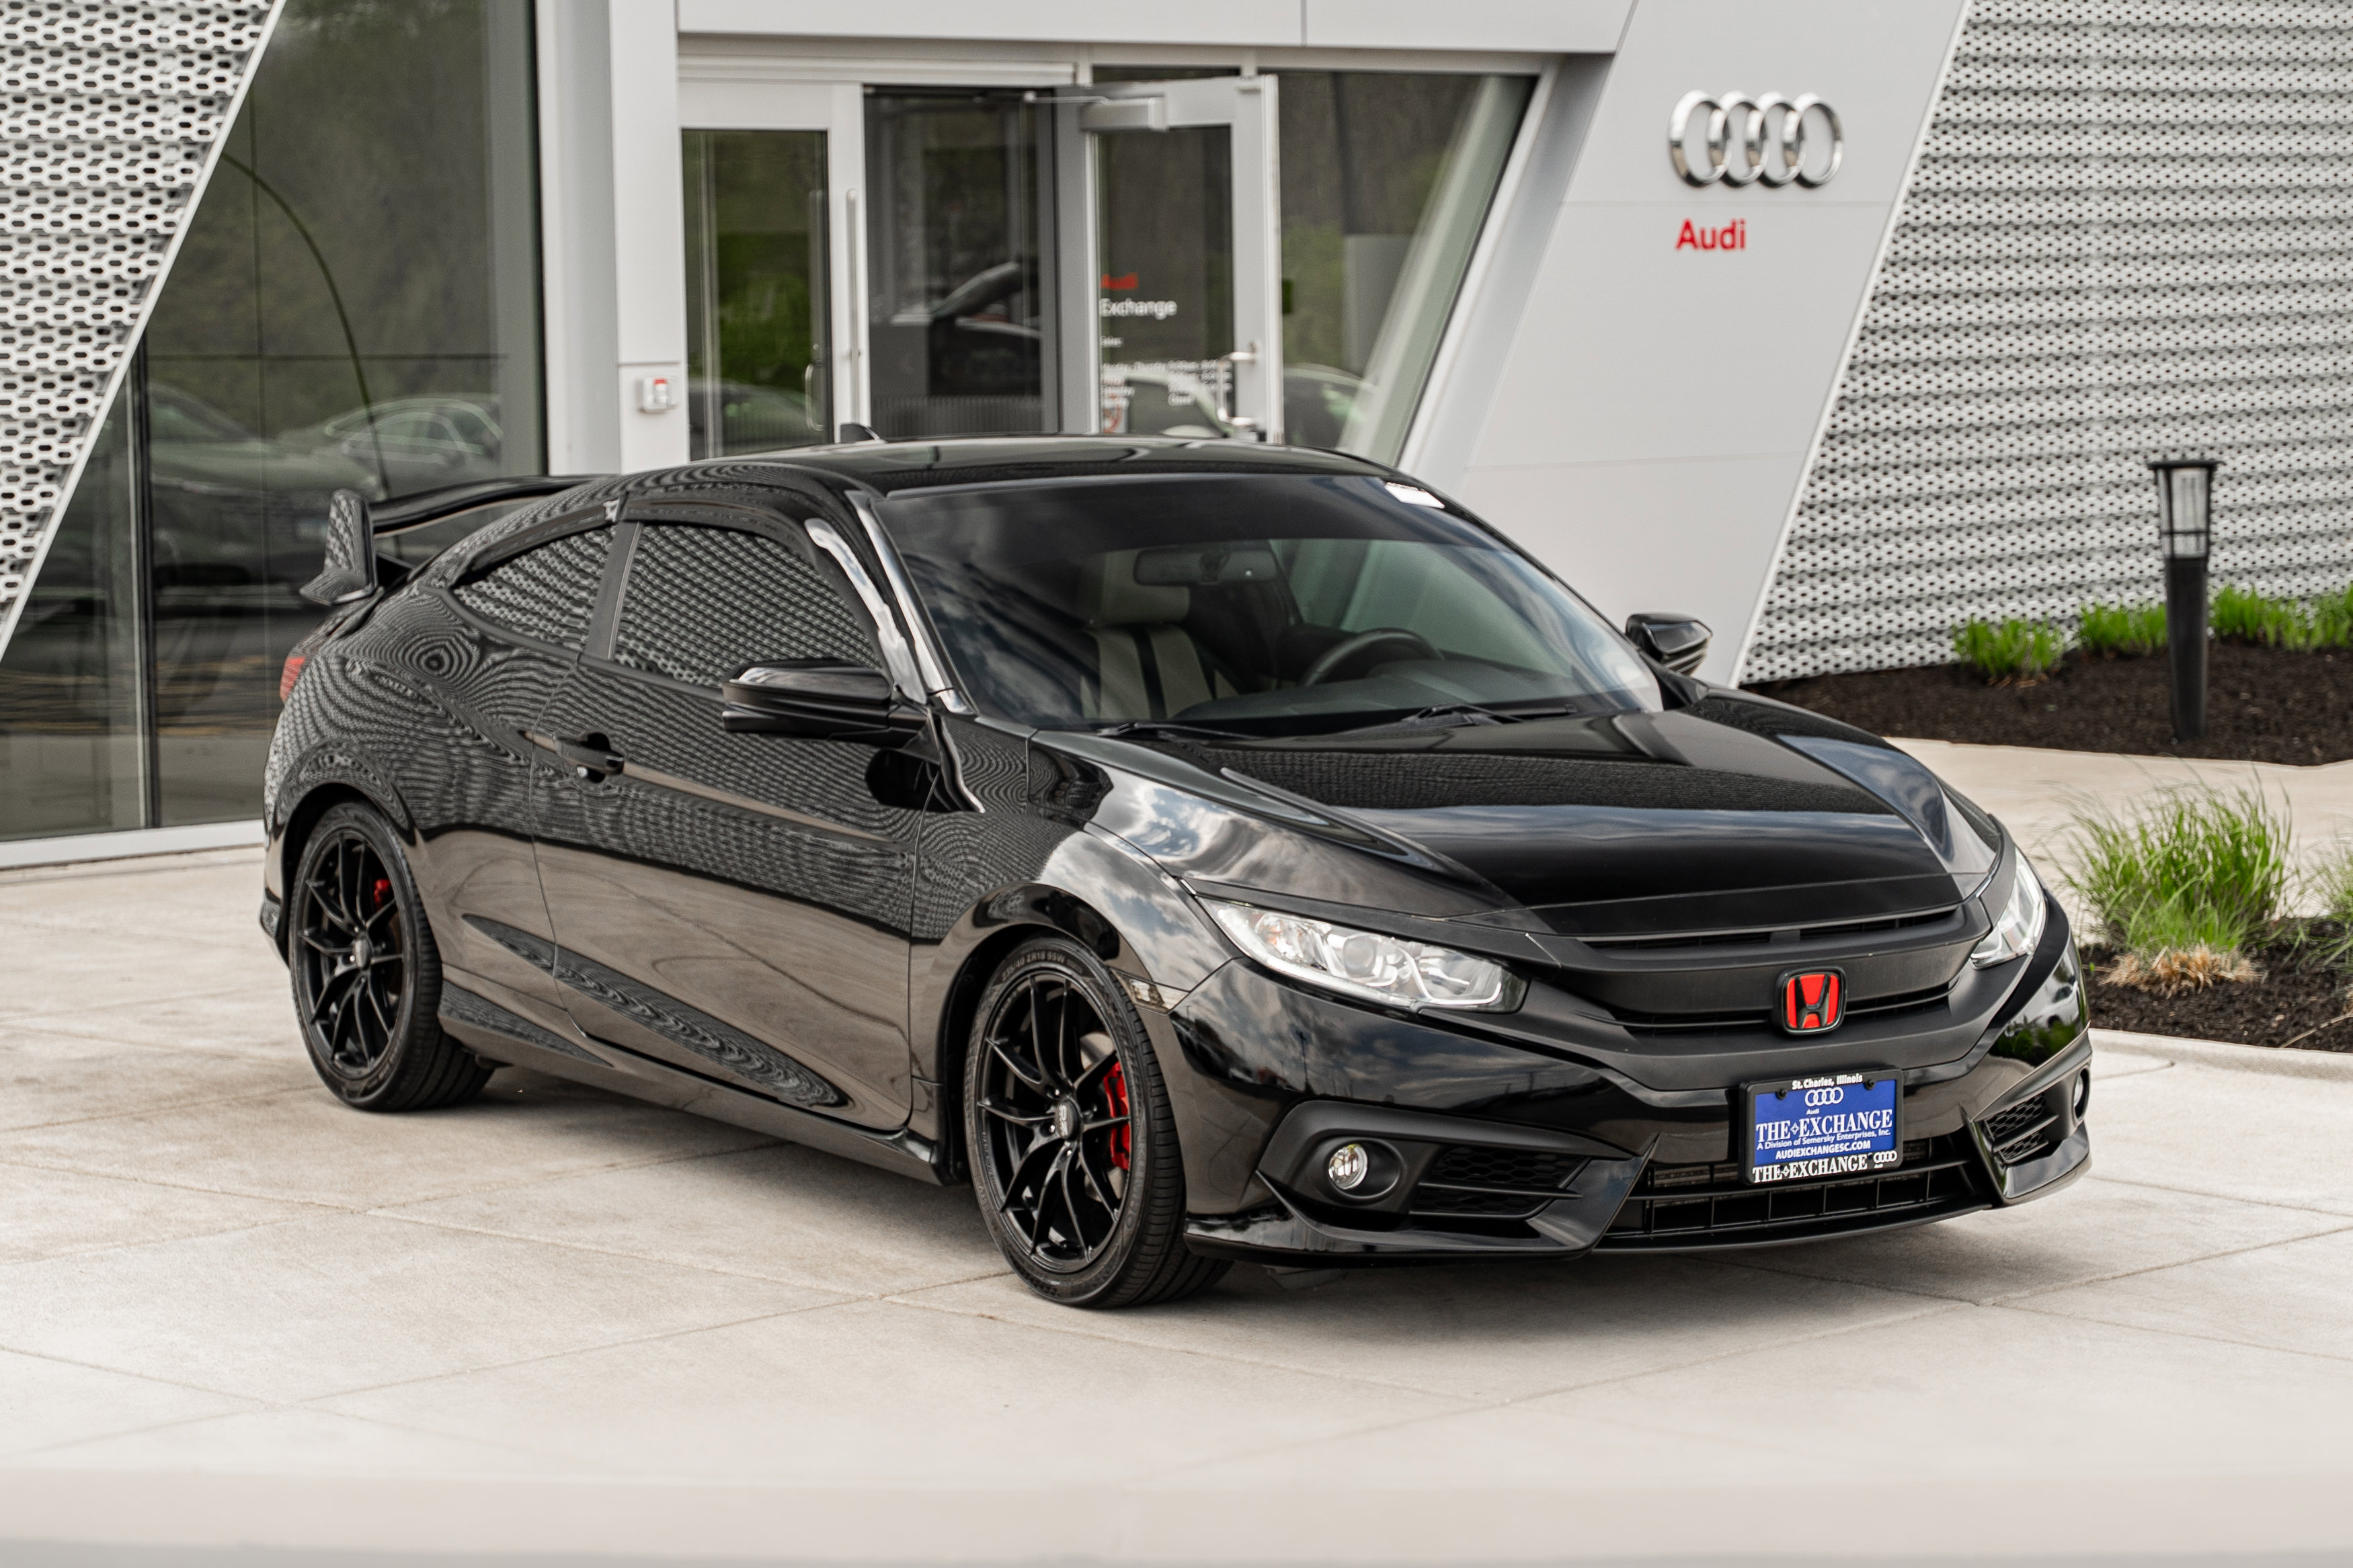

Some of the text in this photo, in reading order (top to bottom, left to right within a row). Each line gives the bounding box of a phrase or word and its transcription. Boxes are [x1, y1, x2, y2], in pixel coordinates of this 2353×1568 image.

[1675, 218, 1746, 251] Audi
[1099, 298, 1176, 320] Exchange
[1792, 1073, 1863, 1089] St. Charles, Illinois
[1756, 1109, 1892, 1143] THE EXCHANGE
[1765, 1140, 1792, 1149] Division
[1837, 1131, 1877, 1141] Enterprises,
[1776, 1140, 1871, 1159] AUDIEXCHANGESC.COM
[1752, 1154, 1868, 1183] THE EXCHANGE
